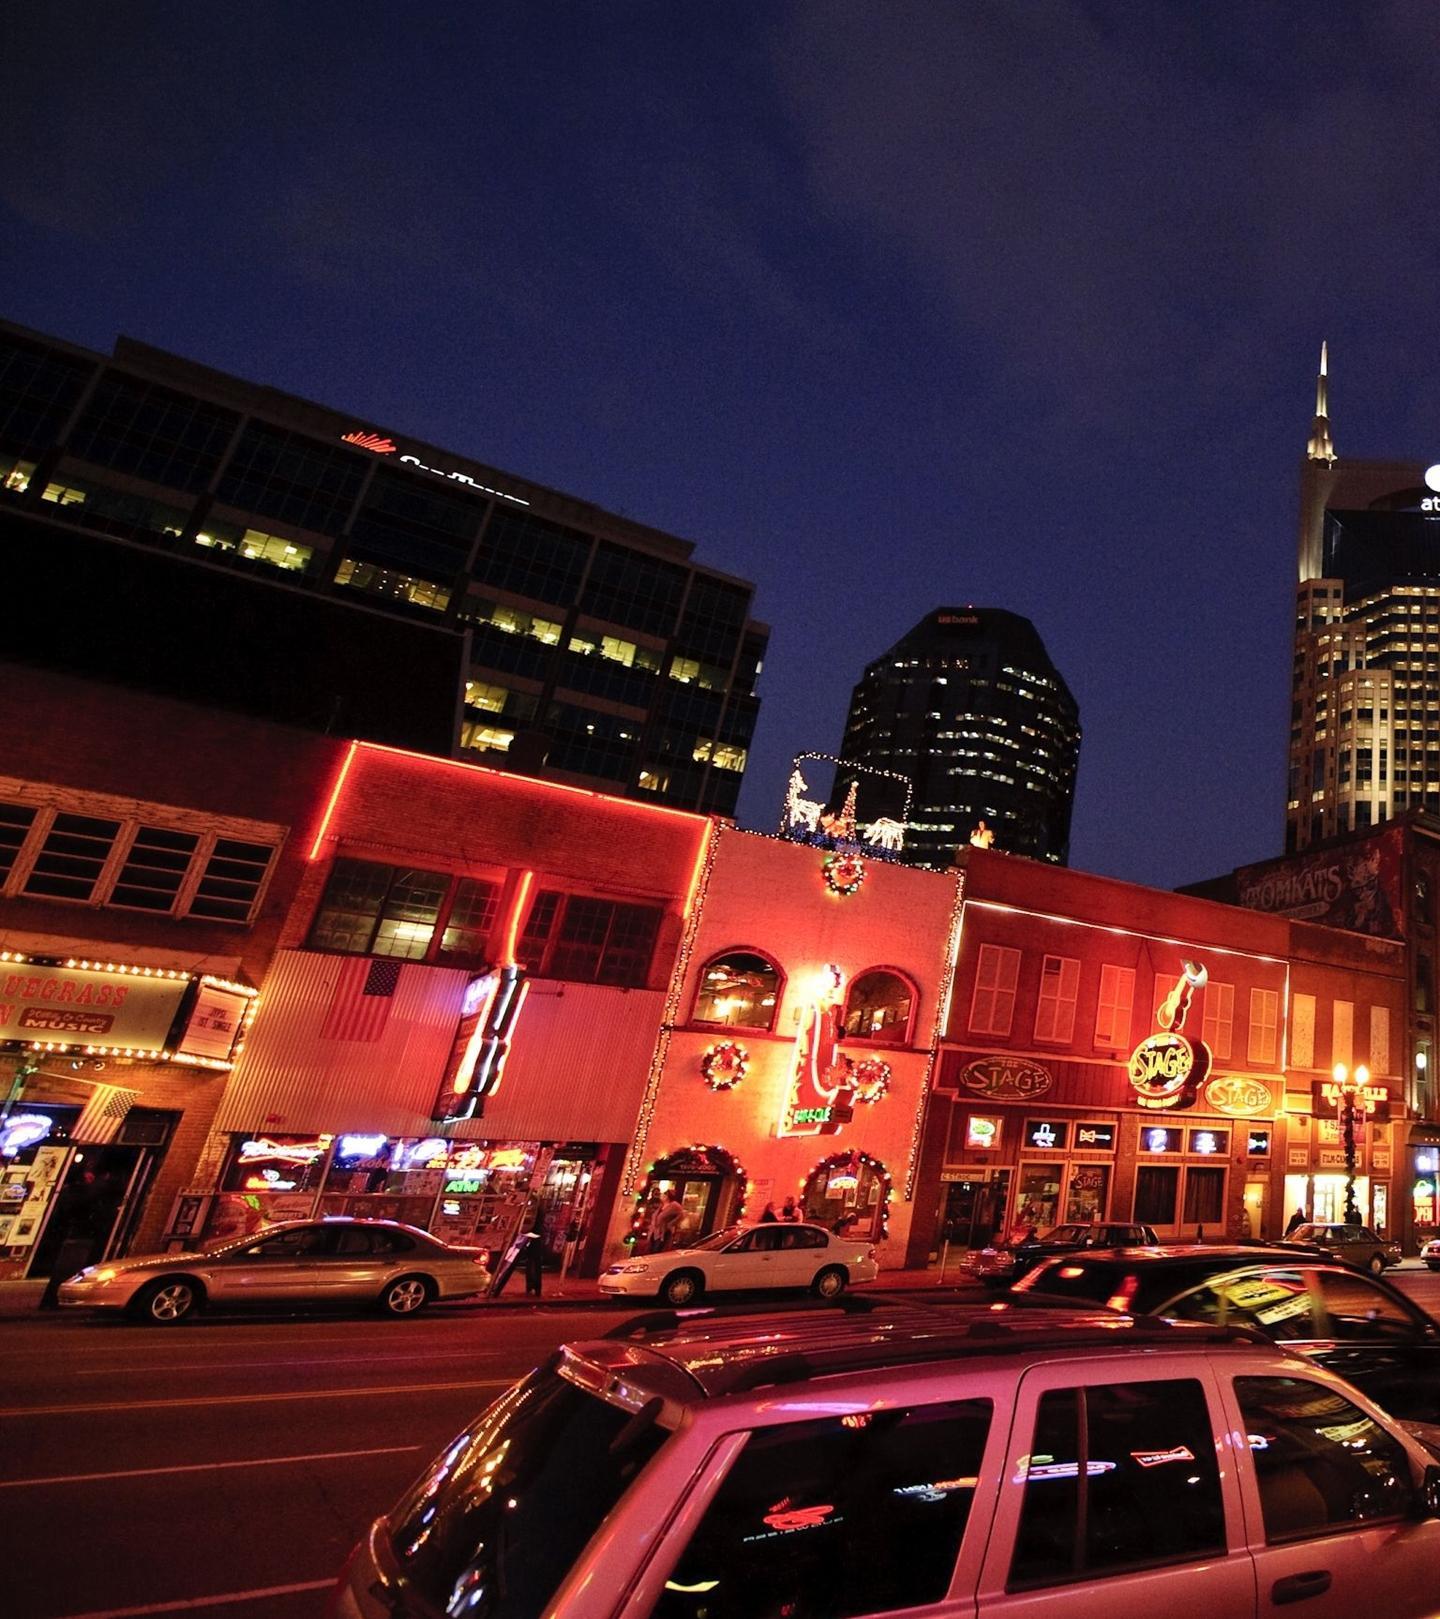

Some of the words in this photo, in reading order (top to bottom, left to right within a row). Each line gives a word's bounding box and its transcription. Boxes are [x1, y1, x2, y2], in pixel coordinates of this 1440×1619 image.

[24, 1019, 104, 1033] MUSIC
[965, 1060, 1049, 1089] STAGE
[1128, 1046, 1192, 1085] STAGE
[1207, 1085, 1270, 1106] STAGE
[445, 1181, 481, 1193] ATM
